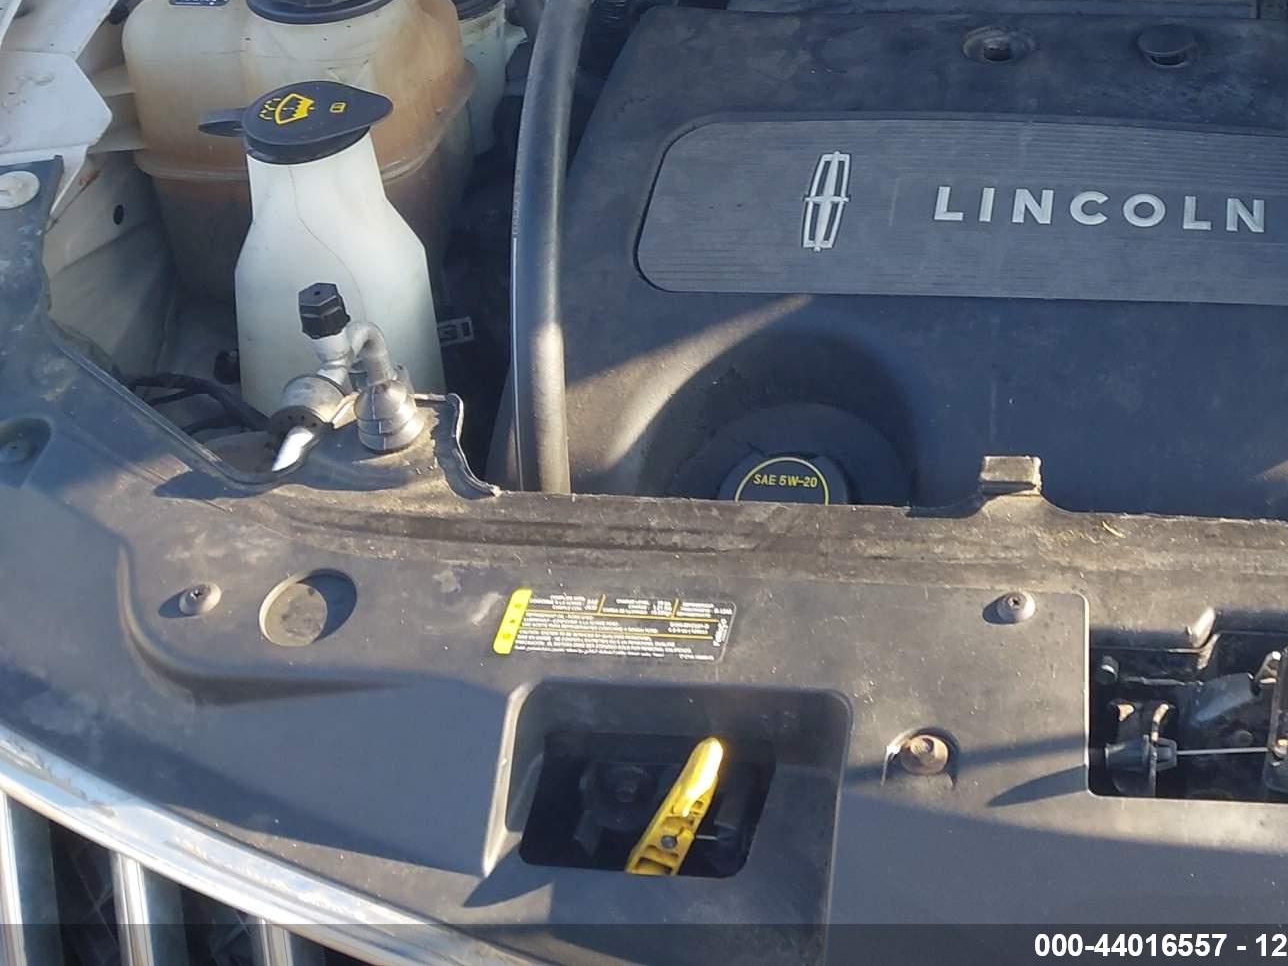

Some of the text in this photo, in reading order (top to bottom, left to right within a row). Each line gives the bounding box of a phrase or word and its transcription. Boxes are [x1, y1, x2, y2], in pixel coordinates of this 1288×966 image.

[933, 185, 1265, 234] LINCOLN
[753, 473, 818, 488] SAE 5W-20
